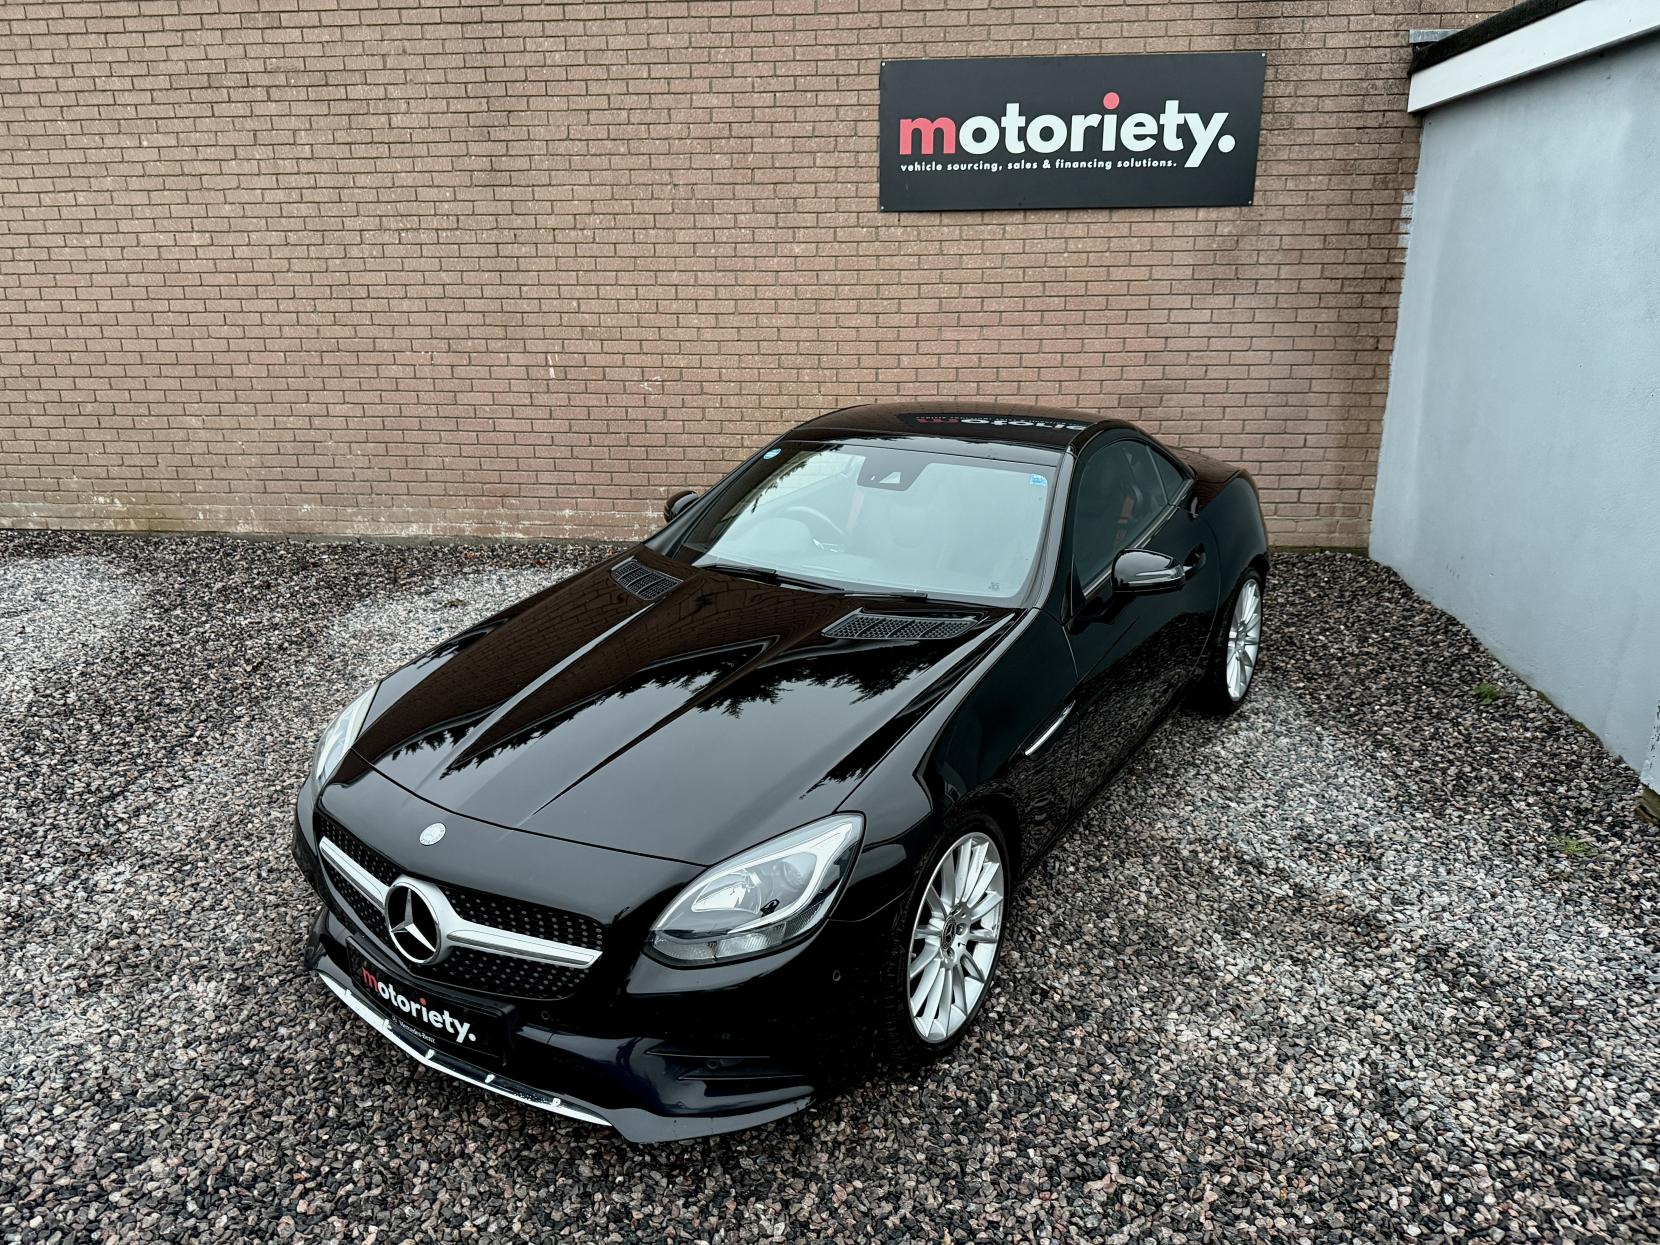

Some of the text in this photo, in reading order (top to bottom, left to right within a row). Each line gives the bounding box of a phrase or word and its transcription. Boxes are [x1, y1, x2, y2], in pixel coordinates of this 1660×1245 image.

[899, 91, 1236, 168] motoriety.
[900, 157, 1177, 173] vehicle sourcing, sales & financing solutions.
[362, 967, 476, 1043] motoriety.
